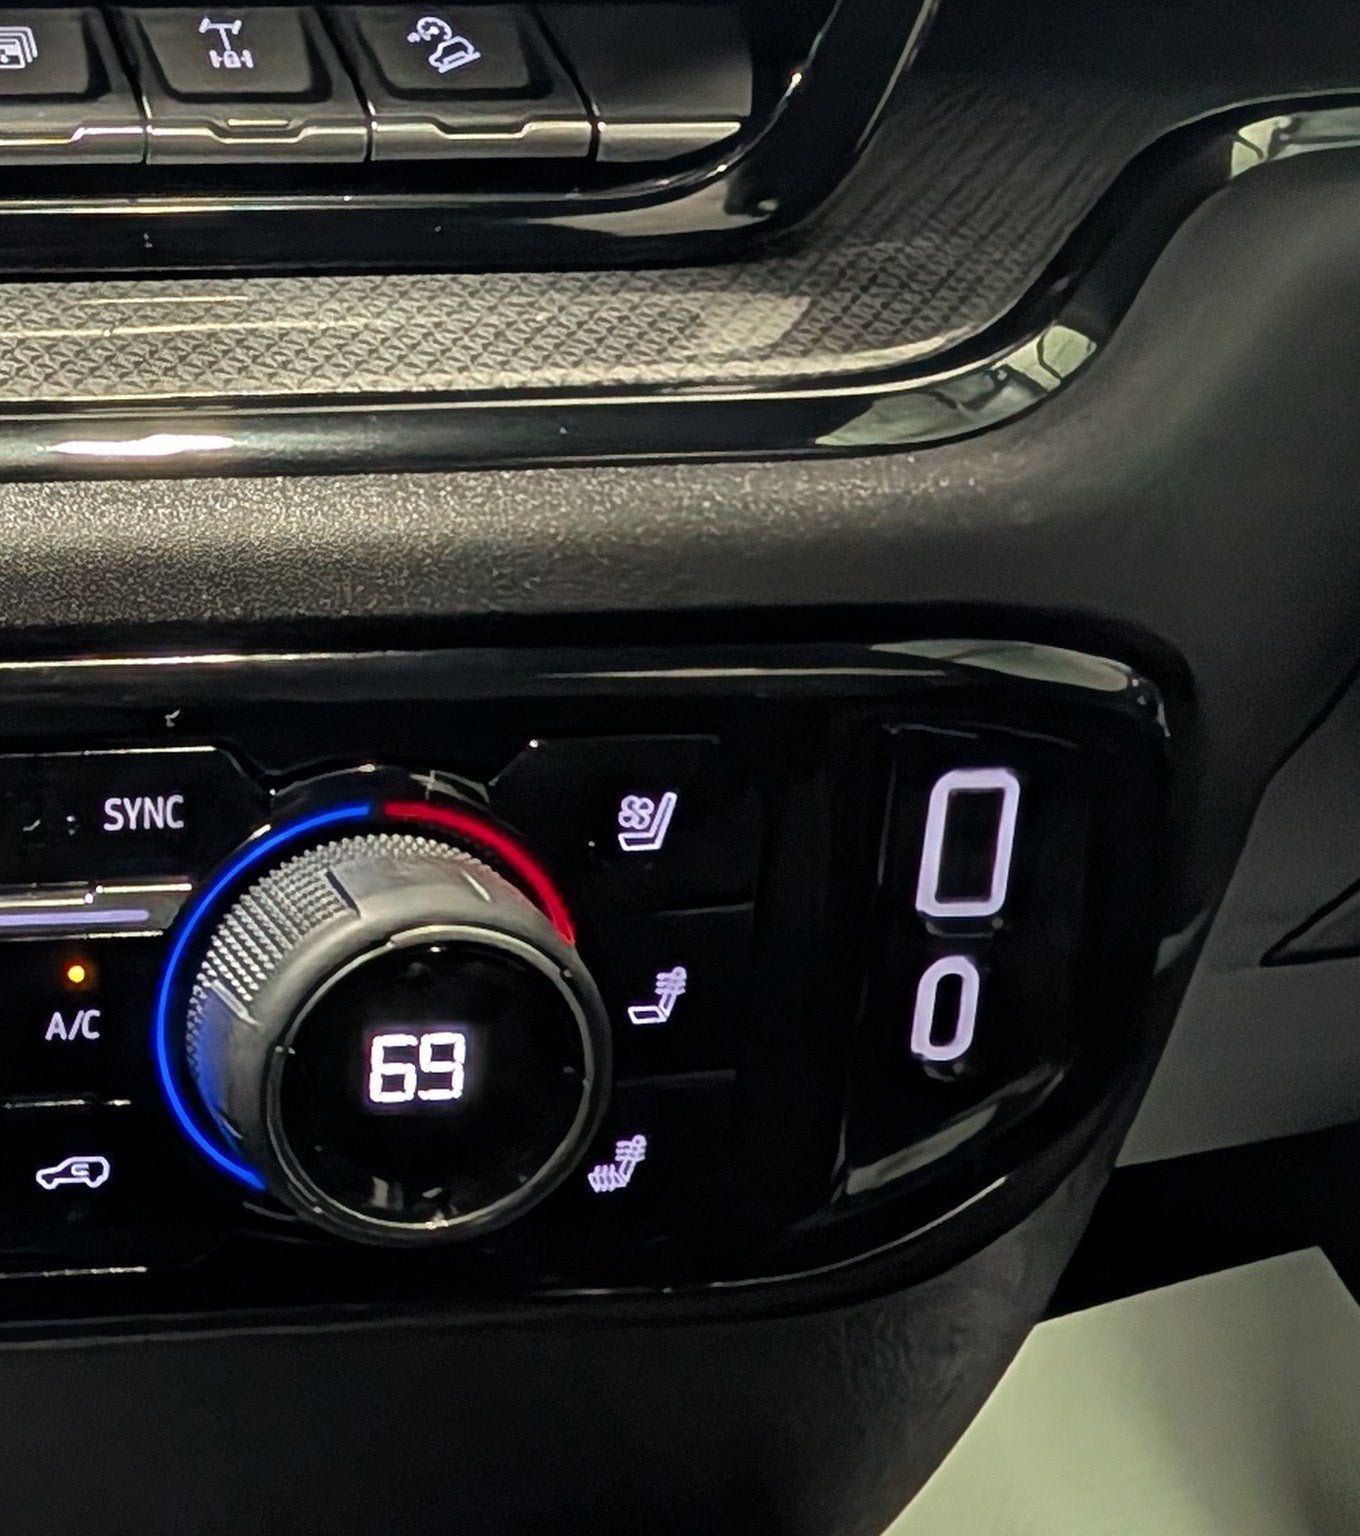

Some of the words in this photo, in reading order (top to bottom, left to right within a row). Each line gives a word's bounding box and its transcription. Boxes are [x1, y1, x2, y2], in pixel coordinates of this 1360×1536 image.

[102, 795, 186, 832] SYNC
[44, 1010, 101, 1042] A/C
[367, 1030, 467, 1104] 69
